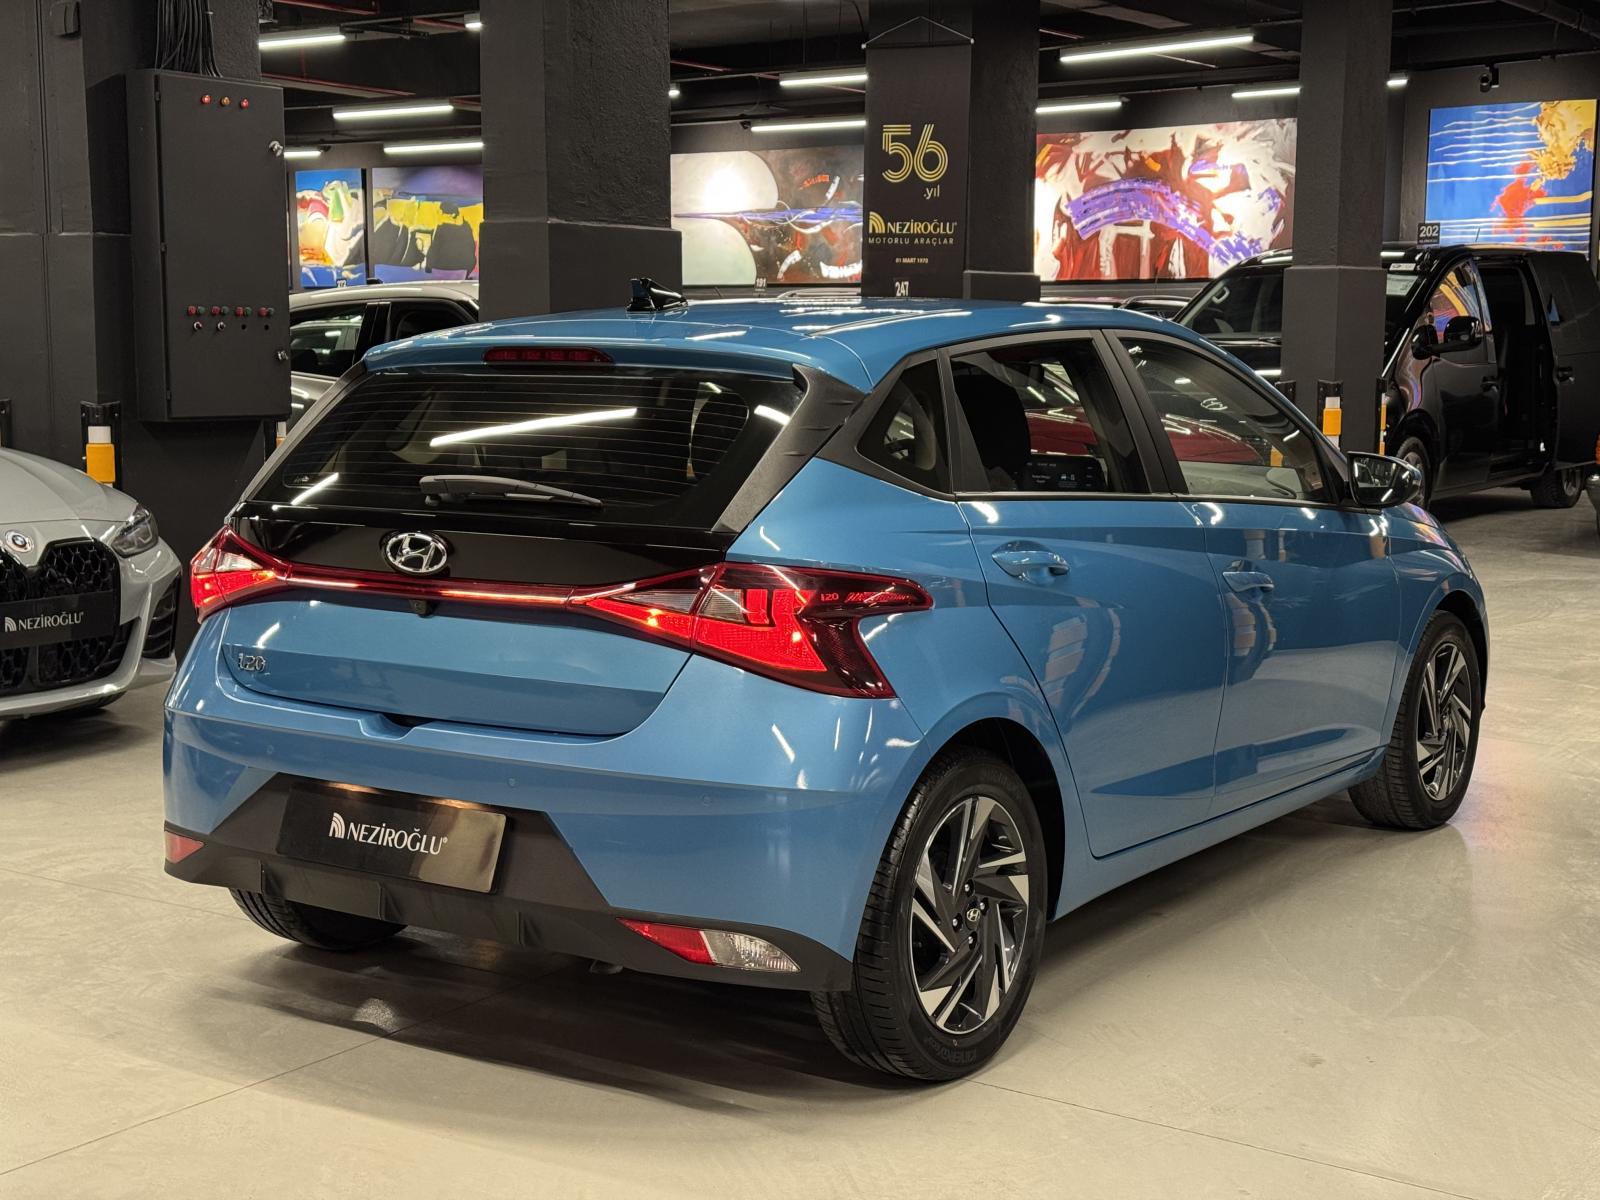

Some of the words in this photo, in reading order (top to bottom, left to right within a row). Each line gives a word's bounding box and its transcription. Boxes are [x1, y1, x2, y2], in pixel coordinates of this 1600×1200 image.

[882, 124, 948, 183] 56
[887, 219, 954, 234] NEZİROĞLU
[1419, 225, 1439, 238] 202
[868, 237, 910, 245] MOTORLU
[914, 237, 954, 247] ARAÇLAR
[895, 281, 910, 297] 247
[19, 611, 82, 631] NEZİROĞLU
[347, 822, 443, 855] NEZİROĞLU
